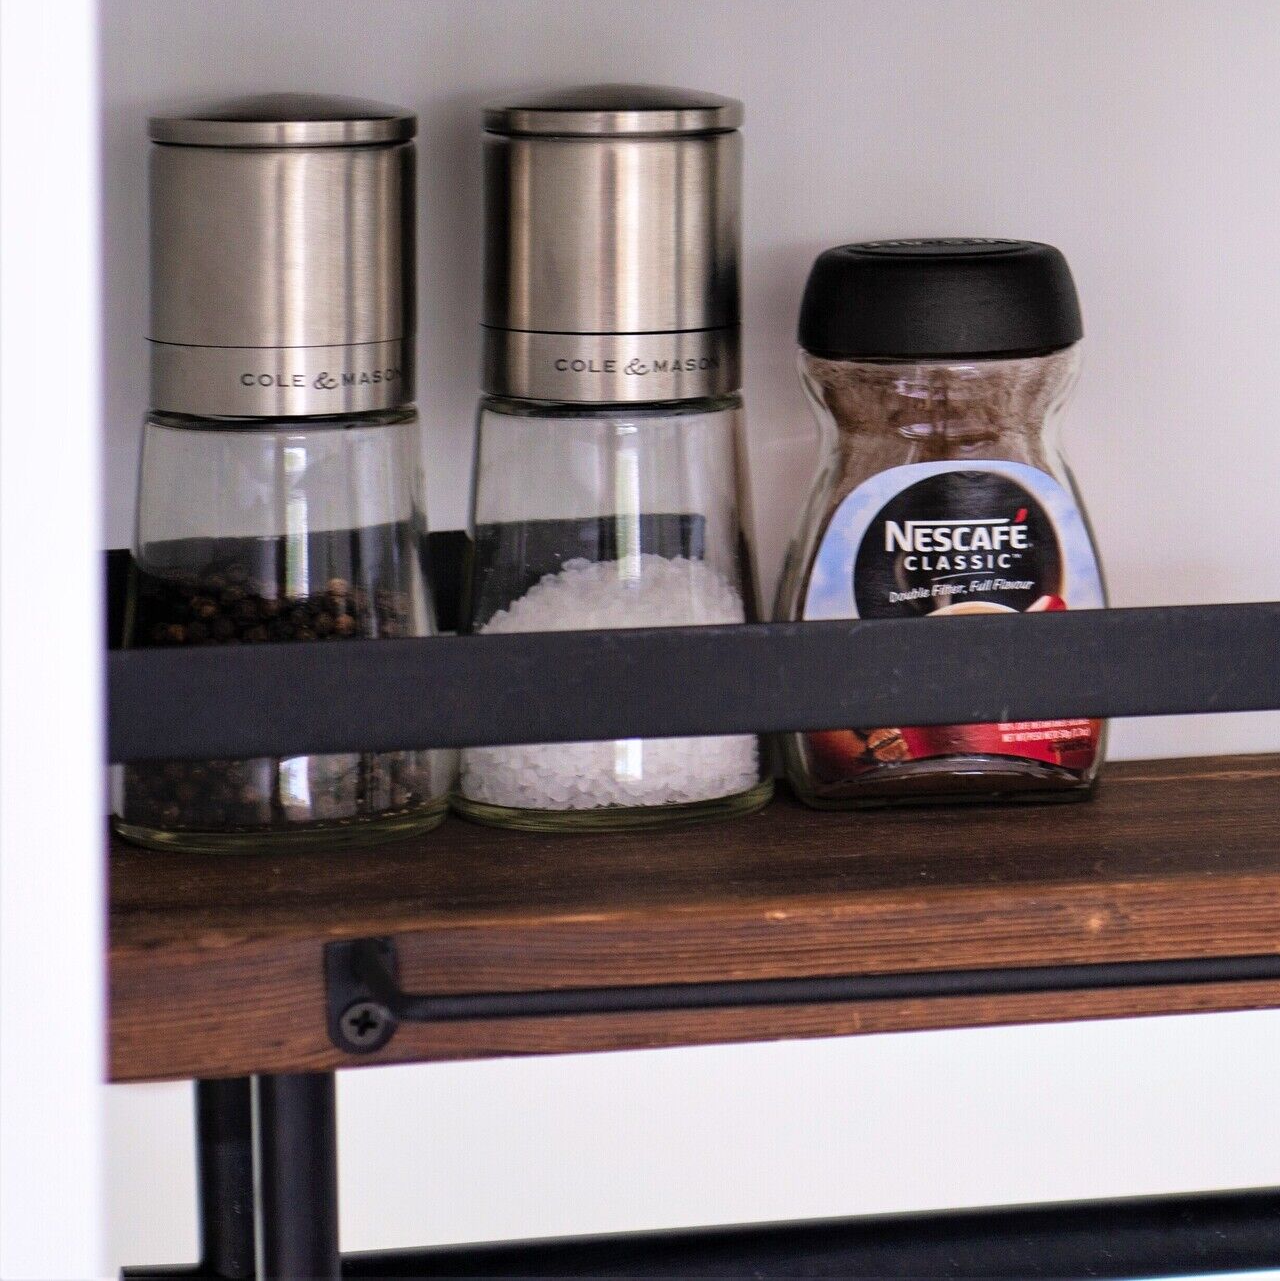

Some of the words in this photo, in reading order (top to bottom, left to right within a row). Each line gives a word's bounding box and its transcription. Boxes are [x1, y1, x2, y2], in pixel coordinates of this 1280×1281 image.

[554, 358, 617, 373] COLE
[624, 358, 650, 376] &
[241, 373, 306, 388] COLE
[313, 371, 339, 390] &
[884, 508, 1028, 552] NESCAFÉ
[889, 587, 931, 603] Double
[969, 580, 993, 592] Full
[992, 578, 1035, 591] Flavour
